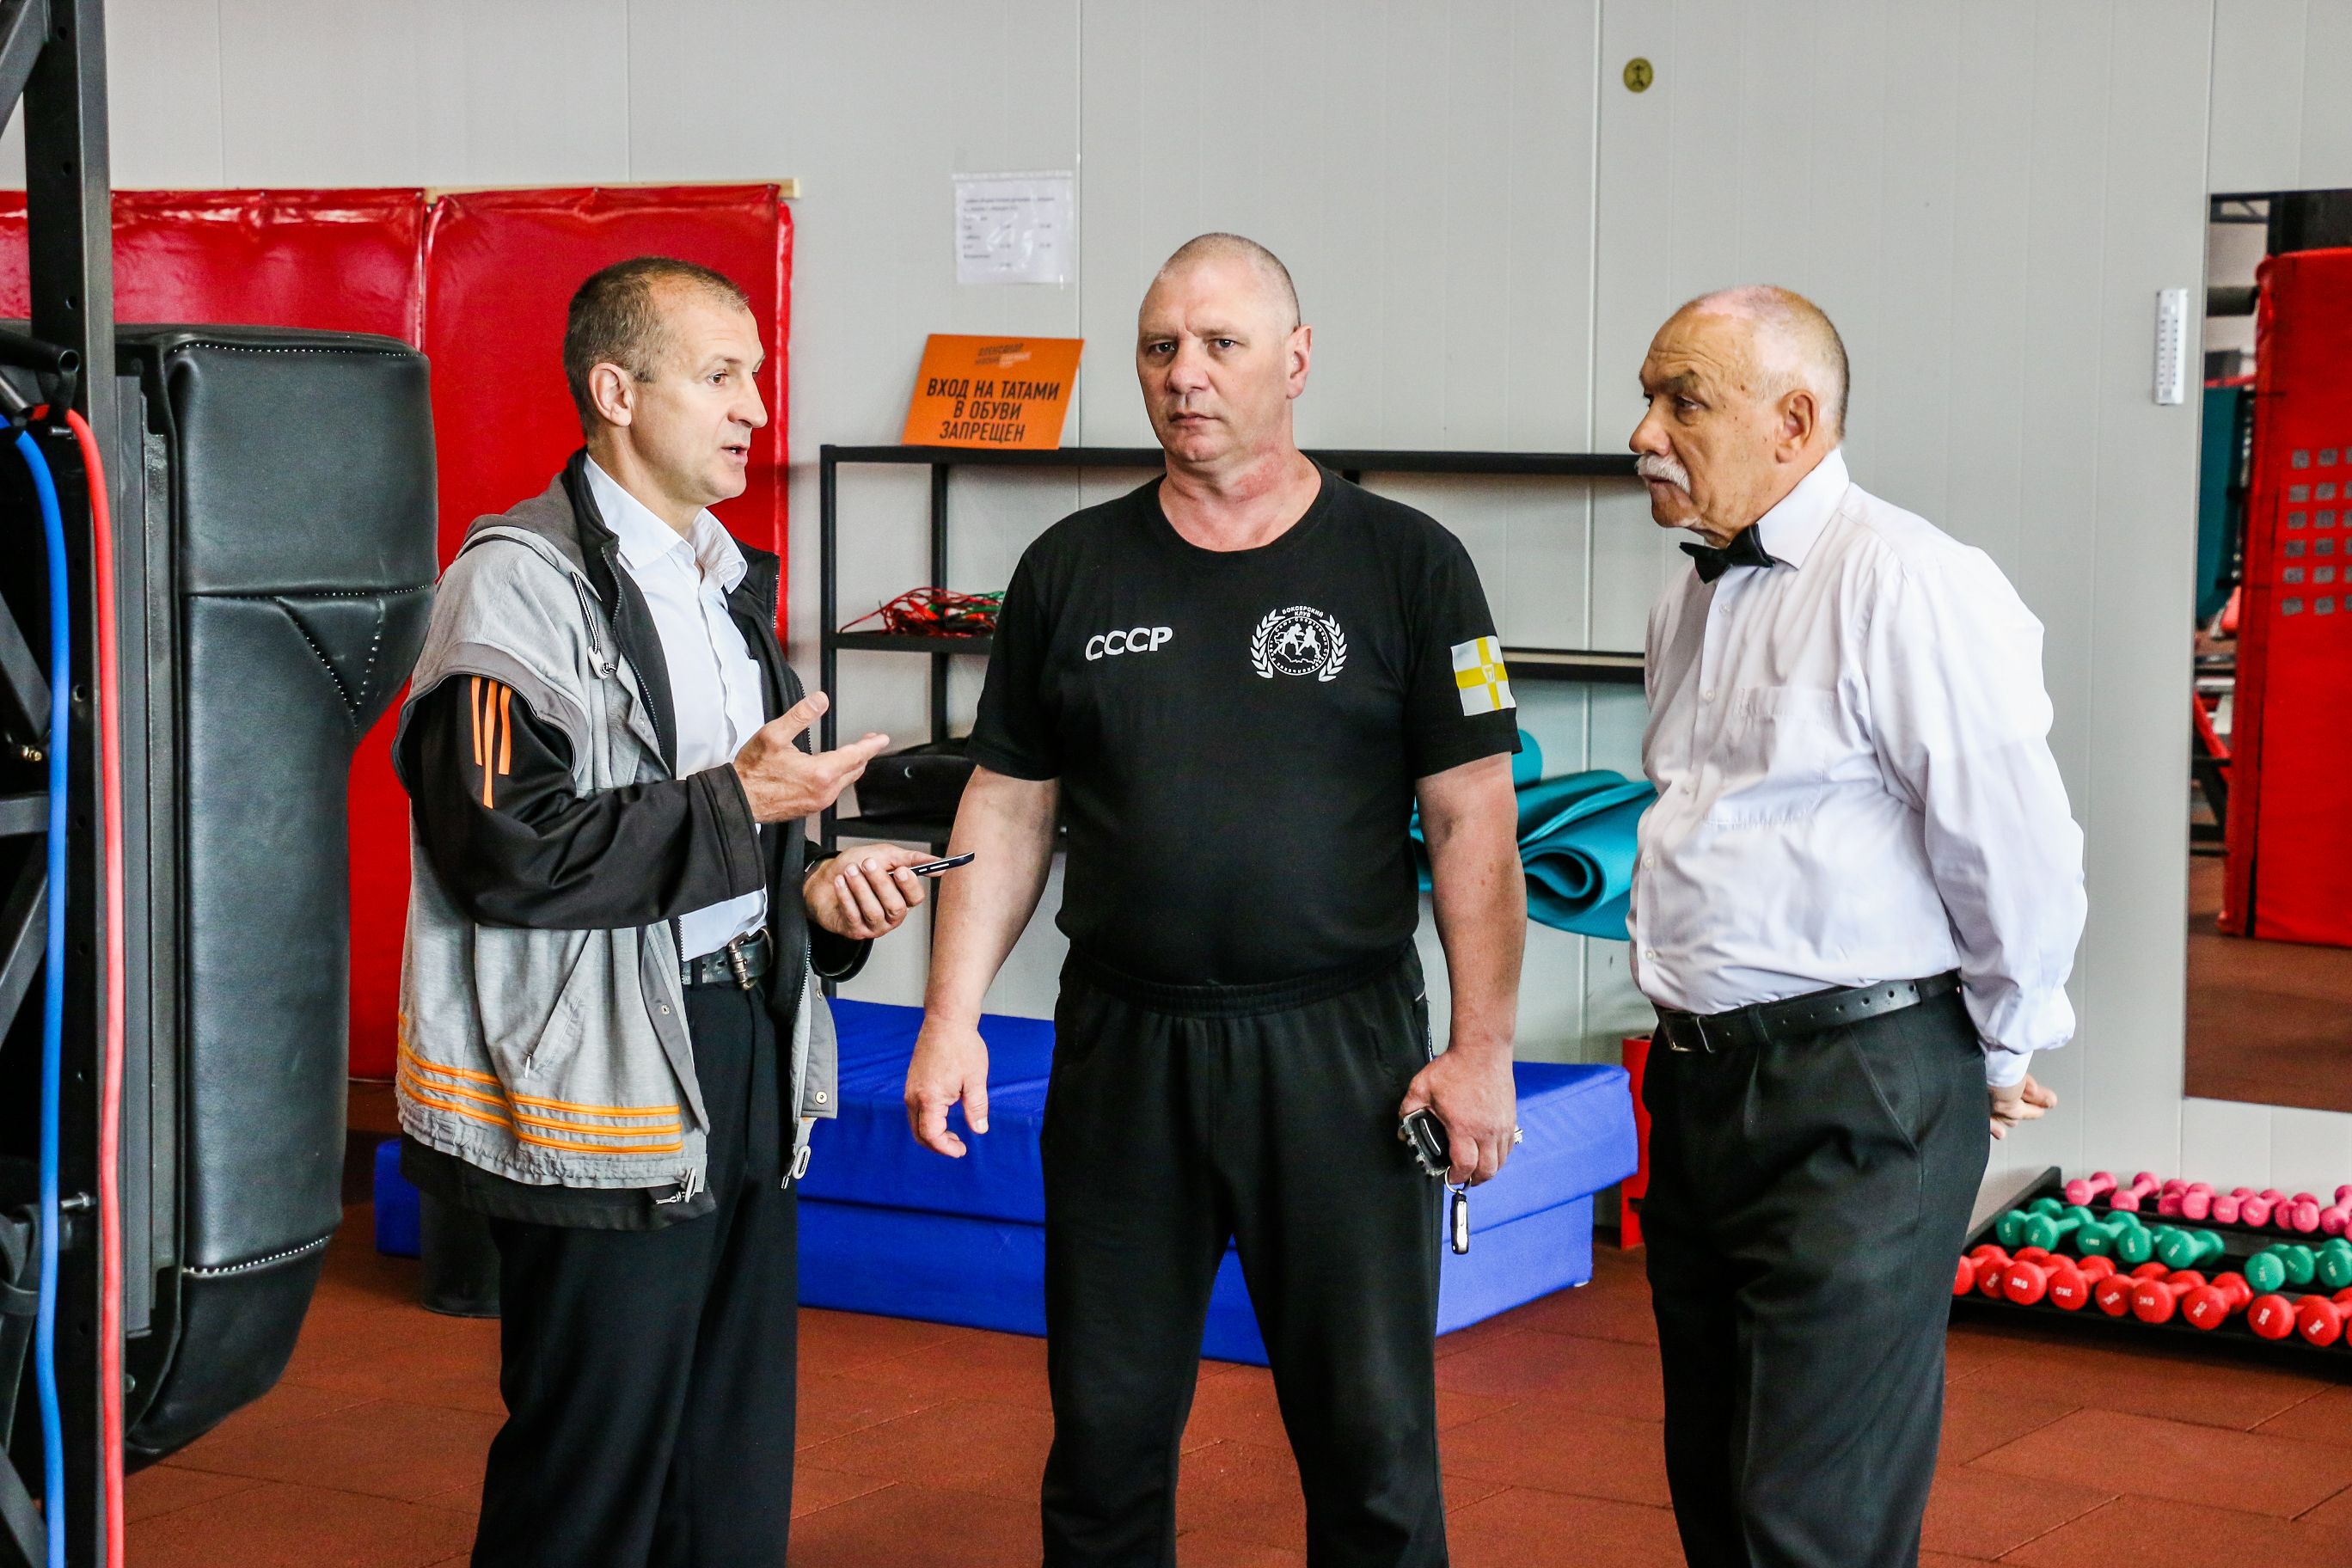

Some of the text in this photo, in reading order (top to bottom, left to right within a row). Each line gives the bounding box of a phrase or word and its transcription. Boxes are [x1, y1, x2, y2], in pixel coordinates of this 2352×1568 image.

[927, 378, 1061, 401] ВХОД НА ТАТАМИ
[953, 401, 1022, 420] В ОБУВИ
[940, 421, 1026, 443] ЗАПРЕЩЕН
[1282, 605, 1324, 617] БОКСЕРСКИЙ
[1085, 626, 1173, 661] СССР
